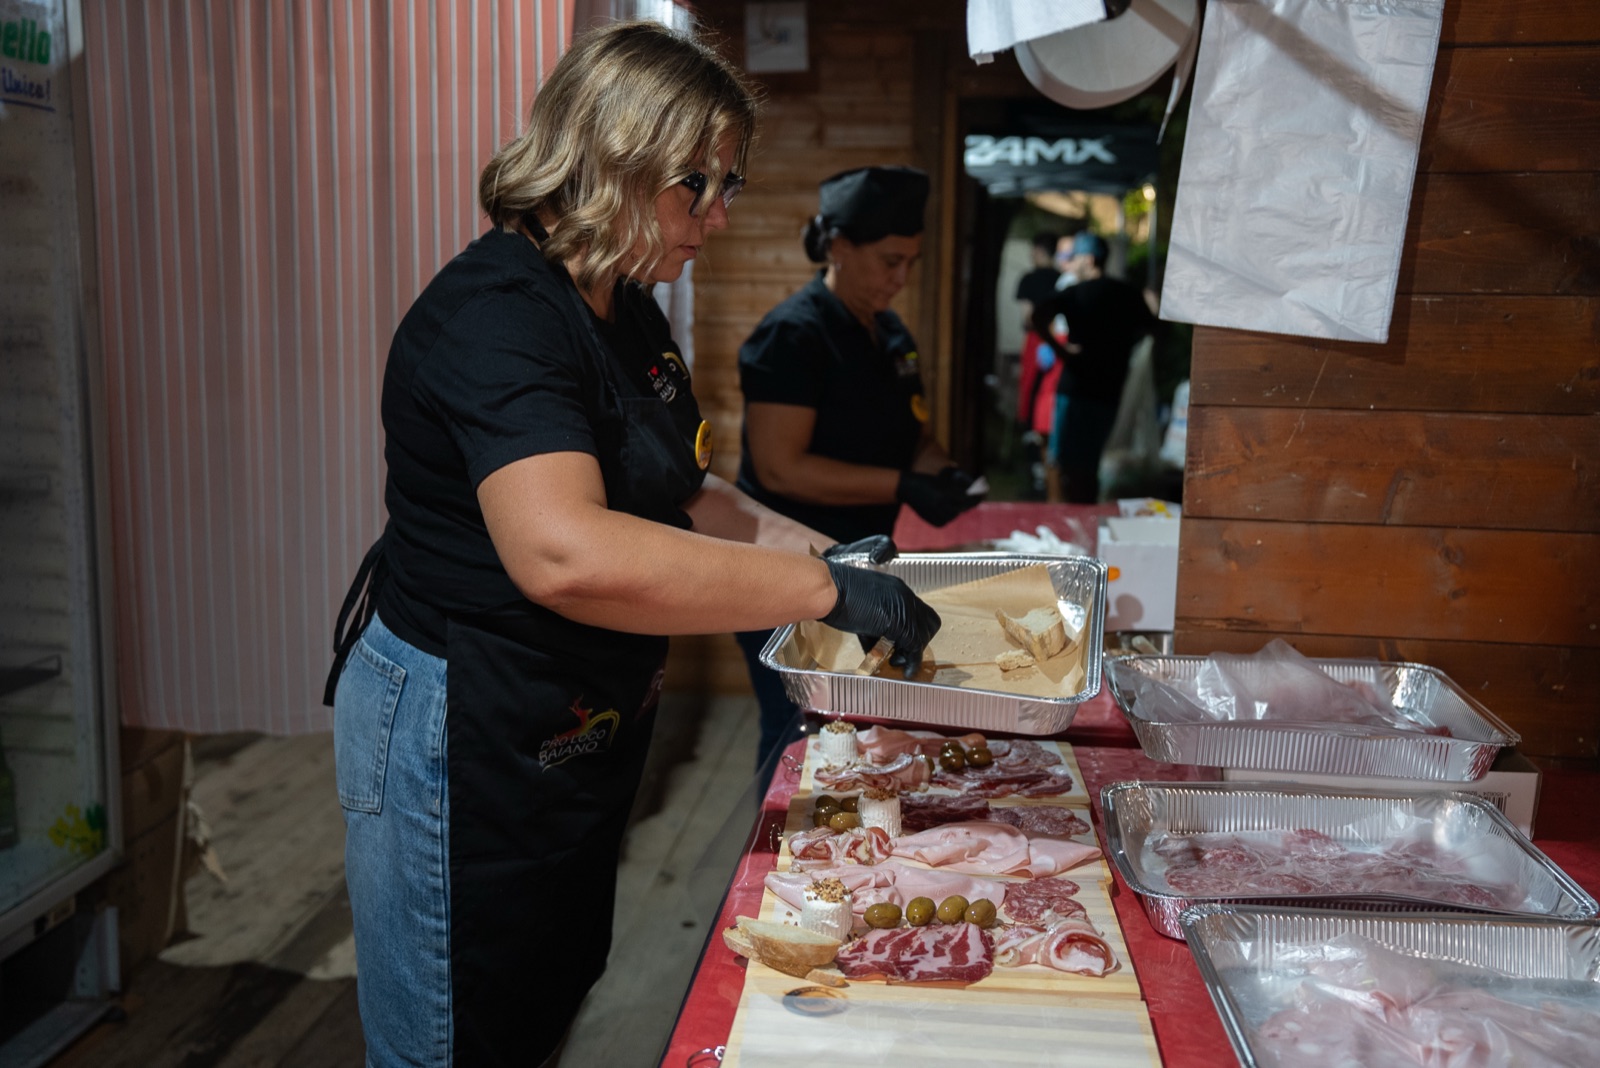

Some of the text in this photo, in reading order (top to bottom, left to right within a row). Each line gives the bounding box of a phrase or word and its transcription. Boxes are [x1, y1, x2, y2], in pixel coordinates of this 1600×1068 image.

[0, 18, 50, 64] ello
[964, 134, 1117, 166] 24MX
[539, 741, 598, 764] BAIANO
[540, 729, 606, 750] PRO LOCO
